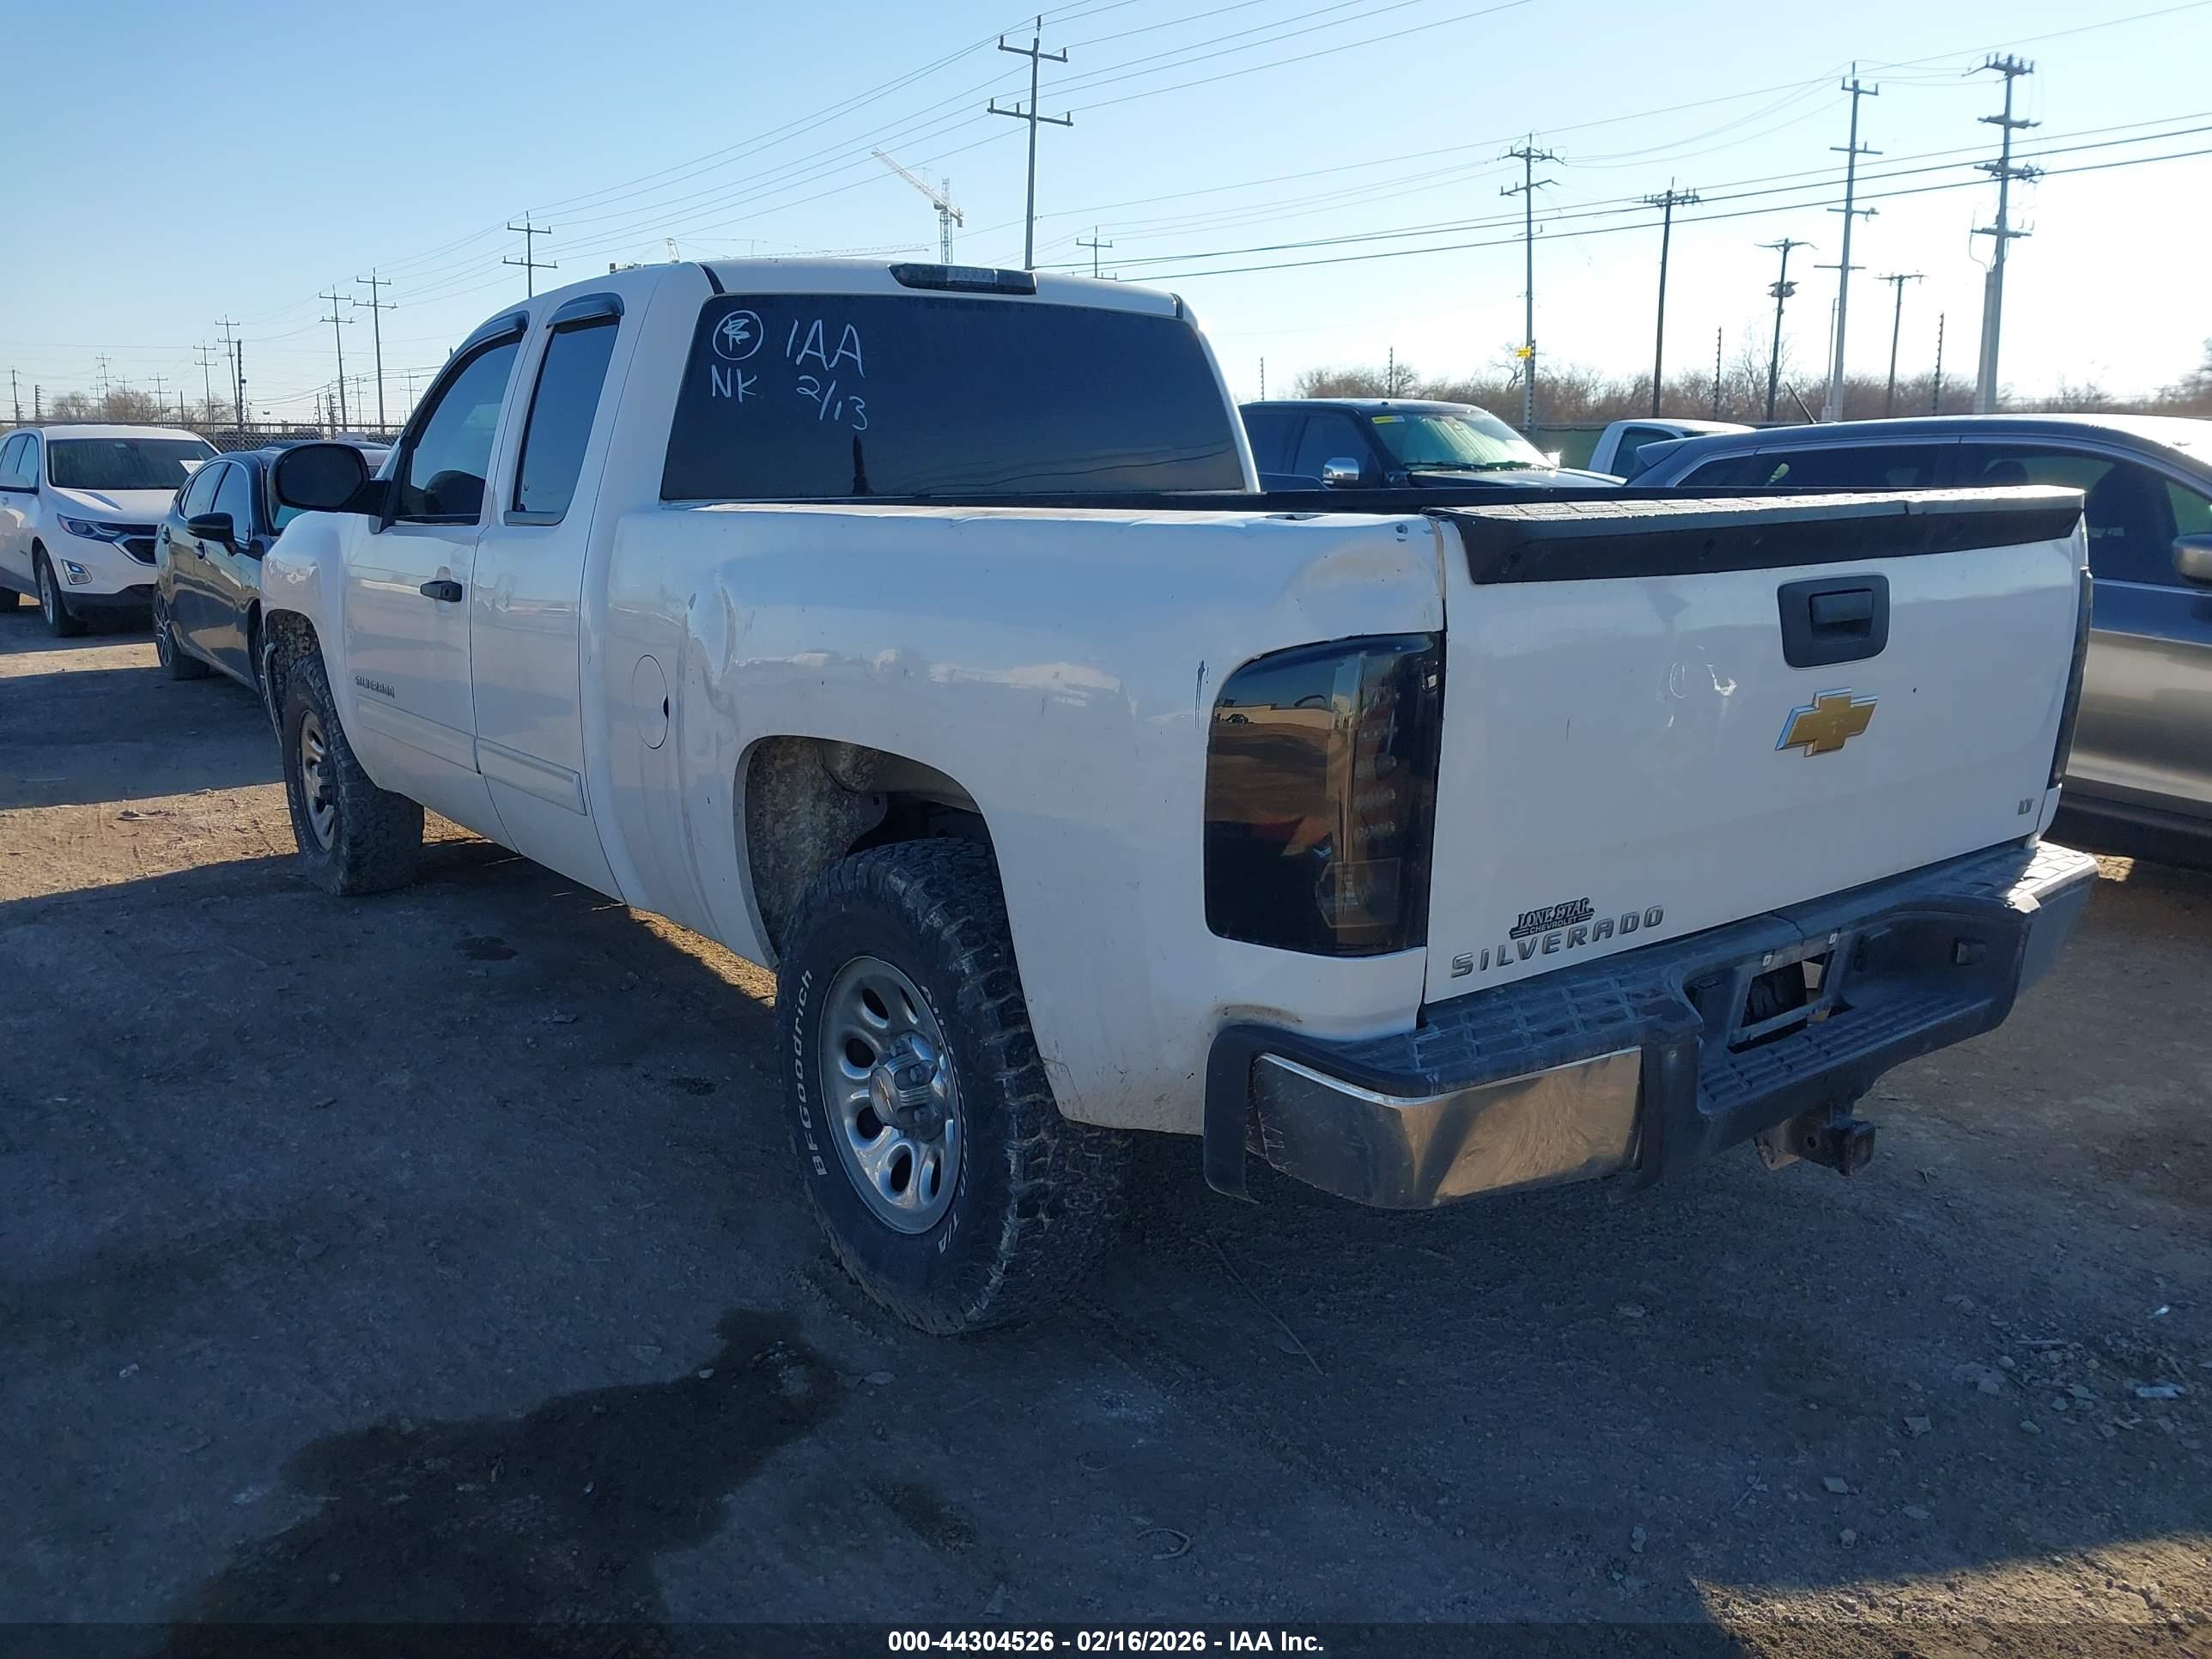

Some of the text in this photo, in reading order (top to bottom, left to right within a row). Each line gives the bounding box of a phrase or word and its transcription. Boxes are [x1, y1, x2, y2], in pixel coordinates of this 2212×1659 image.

[786, 319, 866, 378] IAA
[711, 364, 757, 403] NK
[795, 374, 869, 431] 2/13
[1517, 897, 1594, 929] LONE STAR
[1529, 915, 1577, 933] CHEVROLET
[1449, 905, 1665, 978] SILVERADO
